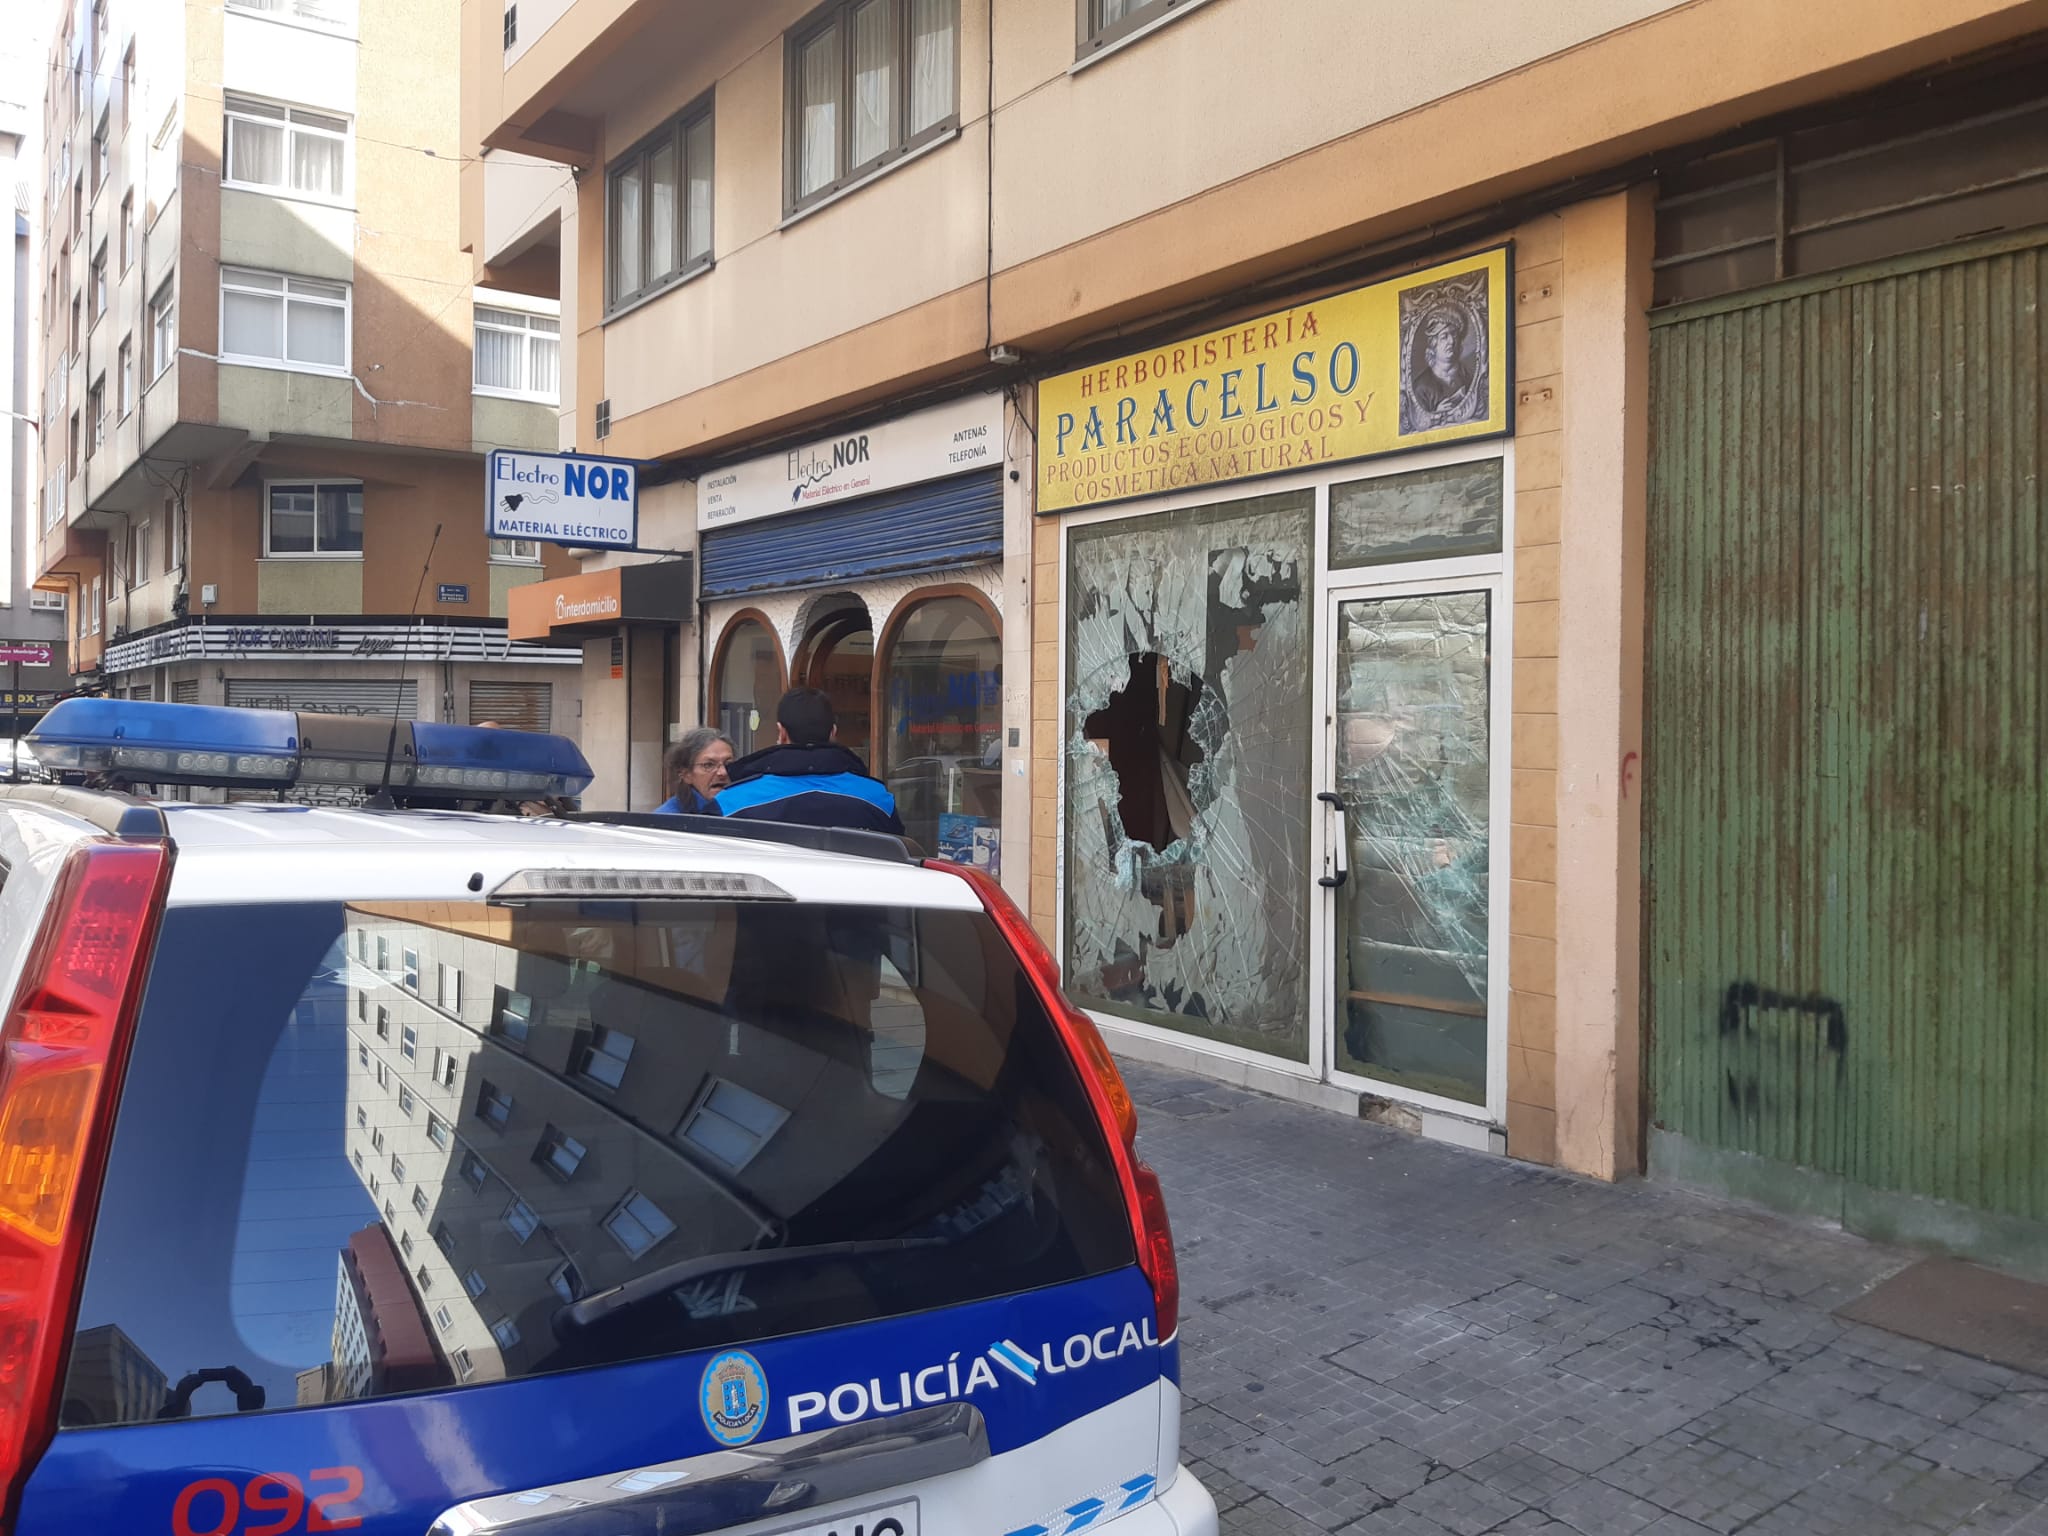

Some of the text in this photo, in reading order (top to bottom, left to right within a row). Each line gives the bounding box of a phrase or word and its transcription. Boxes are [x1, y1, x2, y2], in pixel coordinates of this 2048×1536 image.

[1081, 310, 1320, 398] HERBORISTERÍA
[1056, 341, 1361, 458] PARACELSO
[787, 434, 871, 482] Electro NOR
[948, 443, 987, 464] TELEFONÍA
[953, 424, 988, 443] ANTENAS
[1046, 391, 1376, 485] PRODUCTOS ECOLÓGICOS Y
[496, 456, 630, 502] Electro NOR
[1074, 435, 1334, 503] COSMETICA NATURAL
[707, 493, 723, 505] VENTA
[498, 519, 628, 541] MATERIAL ELÉCTRICO
[788, 1317, 1160, 1433] POLICÍA LOCAL
[172, 1465, 364, 1536] 092
